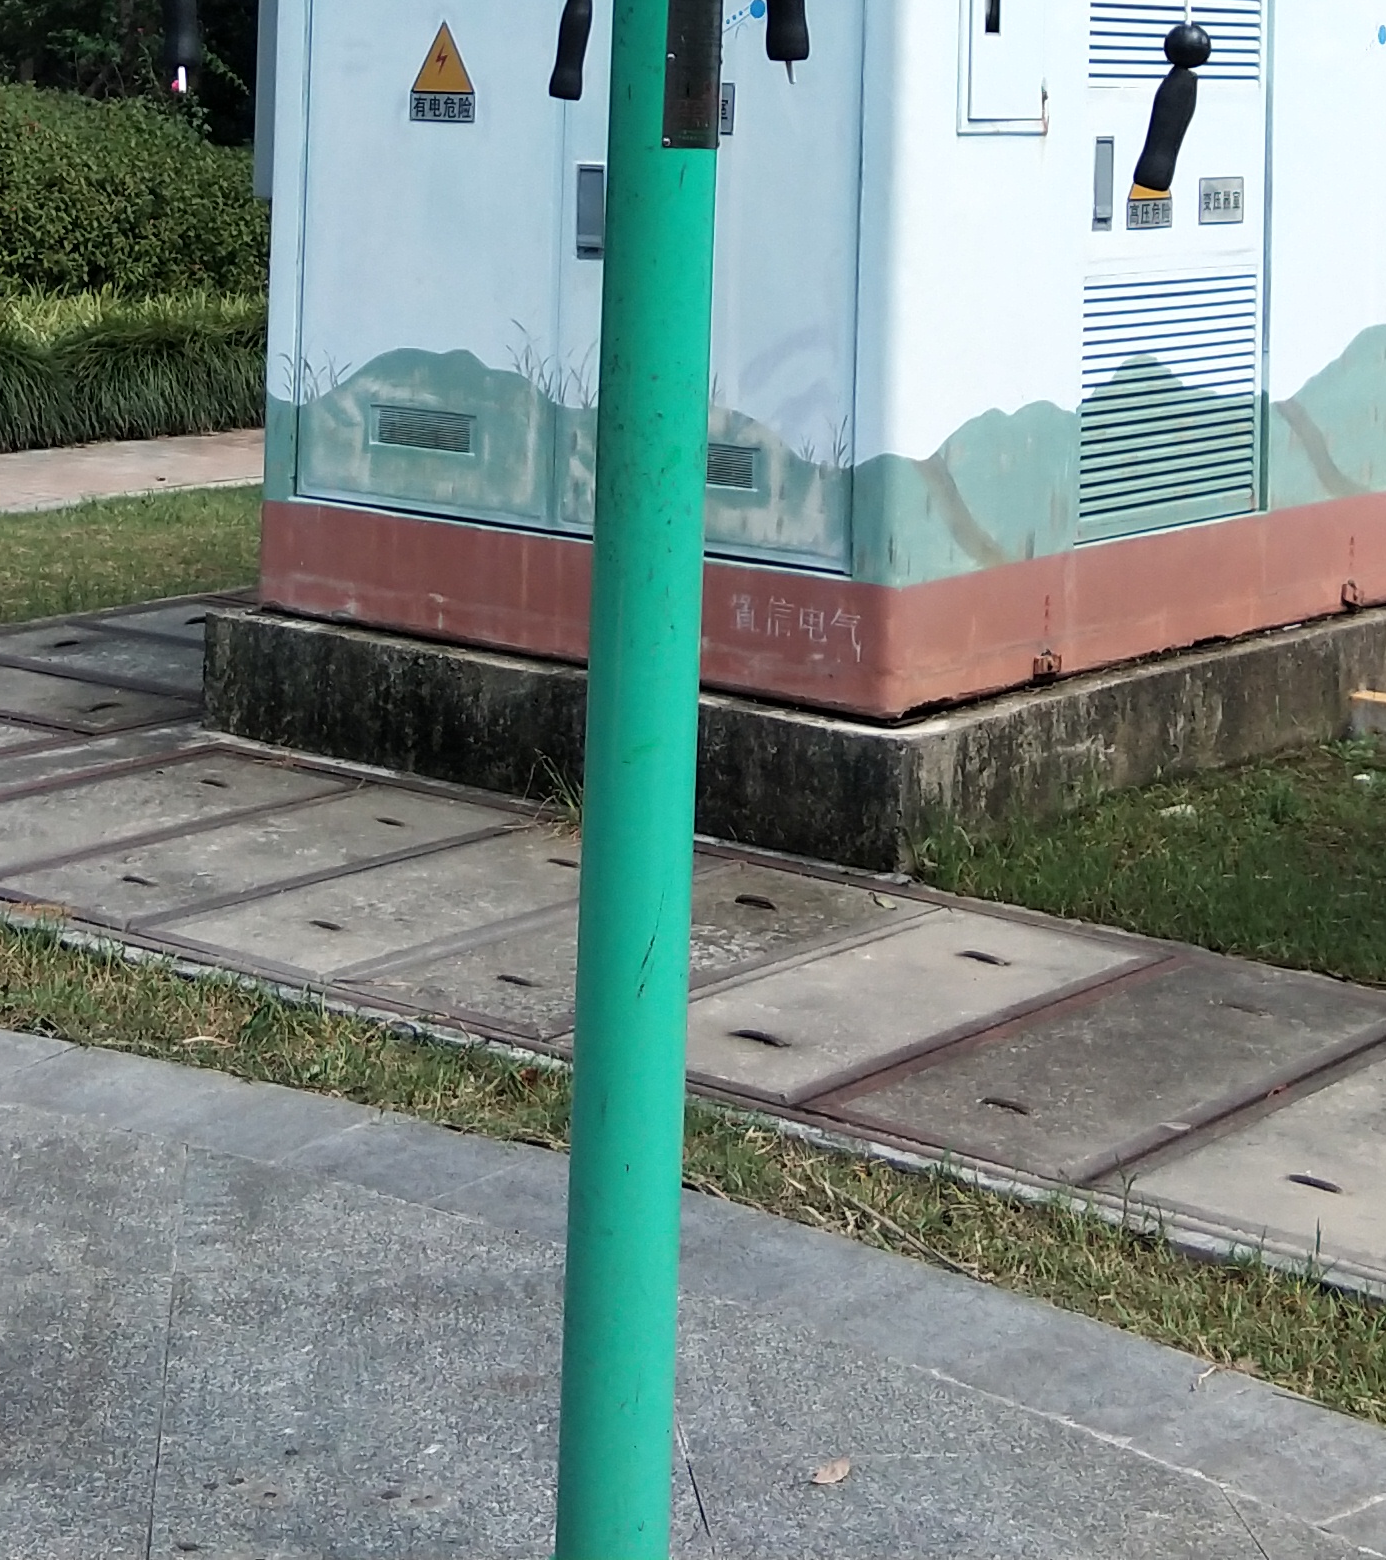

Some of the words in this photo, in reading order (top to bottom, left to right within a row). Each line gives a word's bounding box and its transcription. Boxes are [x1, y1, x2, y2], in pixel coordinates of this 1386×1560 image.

[413, 95, 472, 118] 有电危险
[1129, 202, 1171, 225] 高压危险
